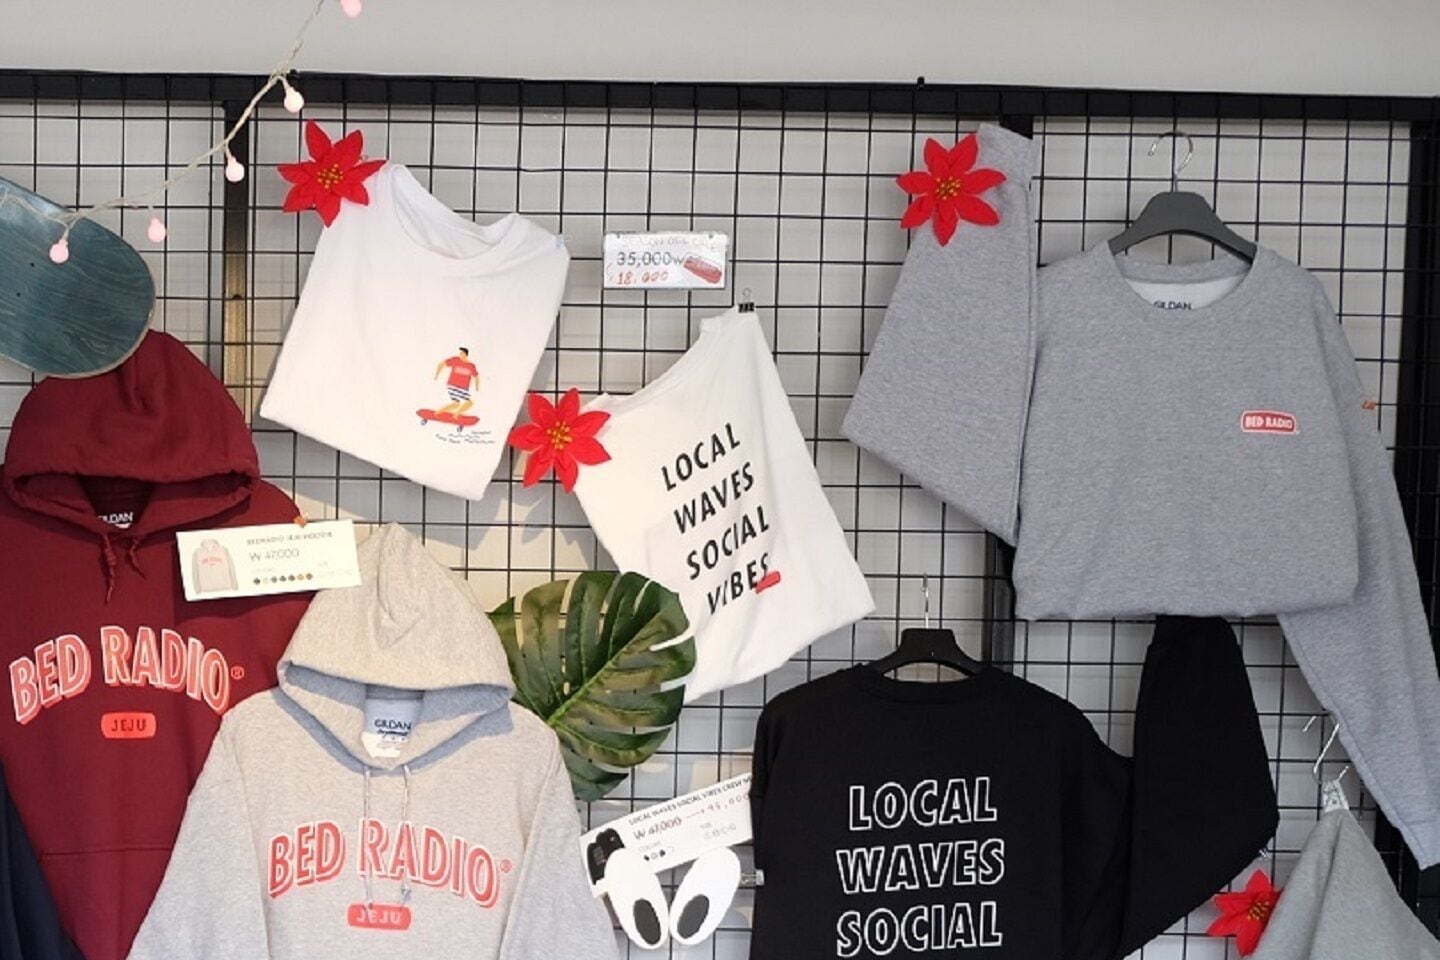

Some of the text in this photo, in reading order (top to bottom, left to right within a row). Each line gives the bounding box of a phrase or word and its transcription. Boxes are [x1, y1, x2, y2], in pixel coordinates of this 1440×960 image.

[1243, 415, 1293, 430] BED RADIO
[661, 422, 740, 492] LOCAL
[674, 461, 754, 535] WAVES
[686, 505, 769, 580] SOCIAL
[707, 552, 769, 616] VIBES
[9, 634, 92, 726] BED
[111, 717, 147, 733] JEJU
[848, 776, 998, 831] LOCAL
[268, 820, 347, 899] BED
[835, 838, 1006, 895] WAVES
[356, 908, 402, 925] JEJU
[836, 901, 1003, 958] SOCIAL
